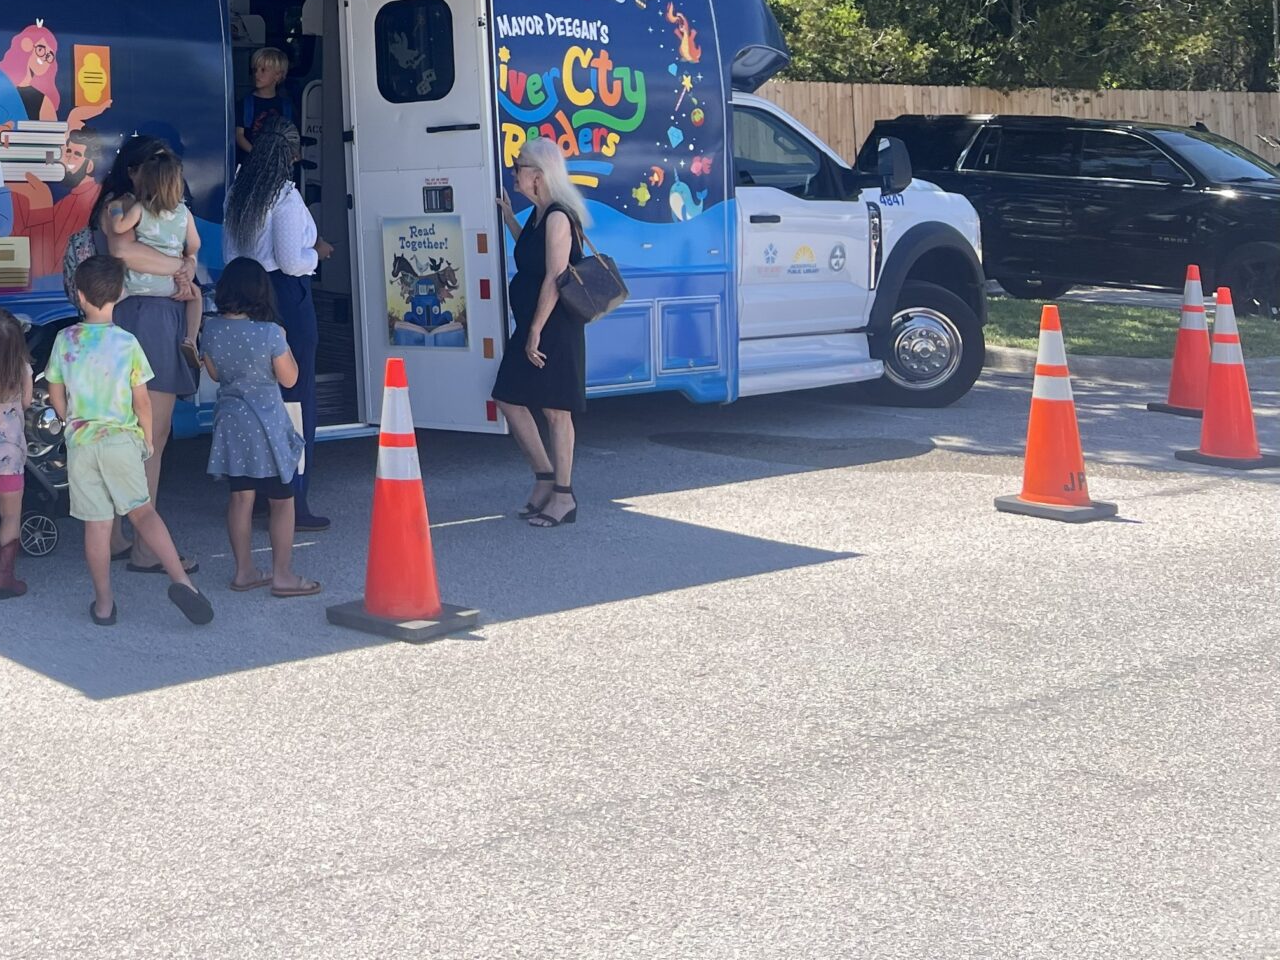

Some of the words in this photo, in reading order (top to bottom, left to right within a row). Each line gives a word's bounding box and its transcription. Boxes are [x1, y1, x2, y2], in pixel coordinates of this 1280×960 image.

[496, 13, 545, 39] MAYOR
[497, 45, 560, 123] iver
[562, 45, 646, 133] City
[880, 193, 905, 206] 4847
[409, 222, 435, 238] Read
[398, 236, 448, 251] Together!
